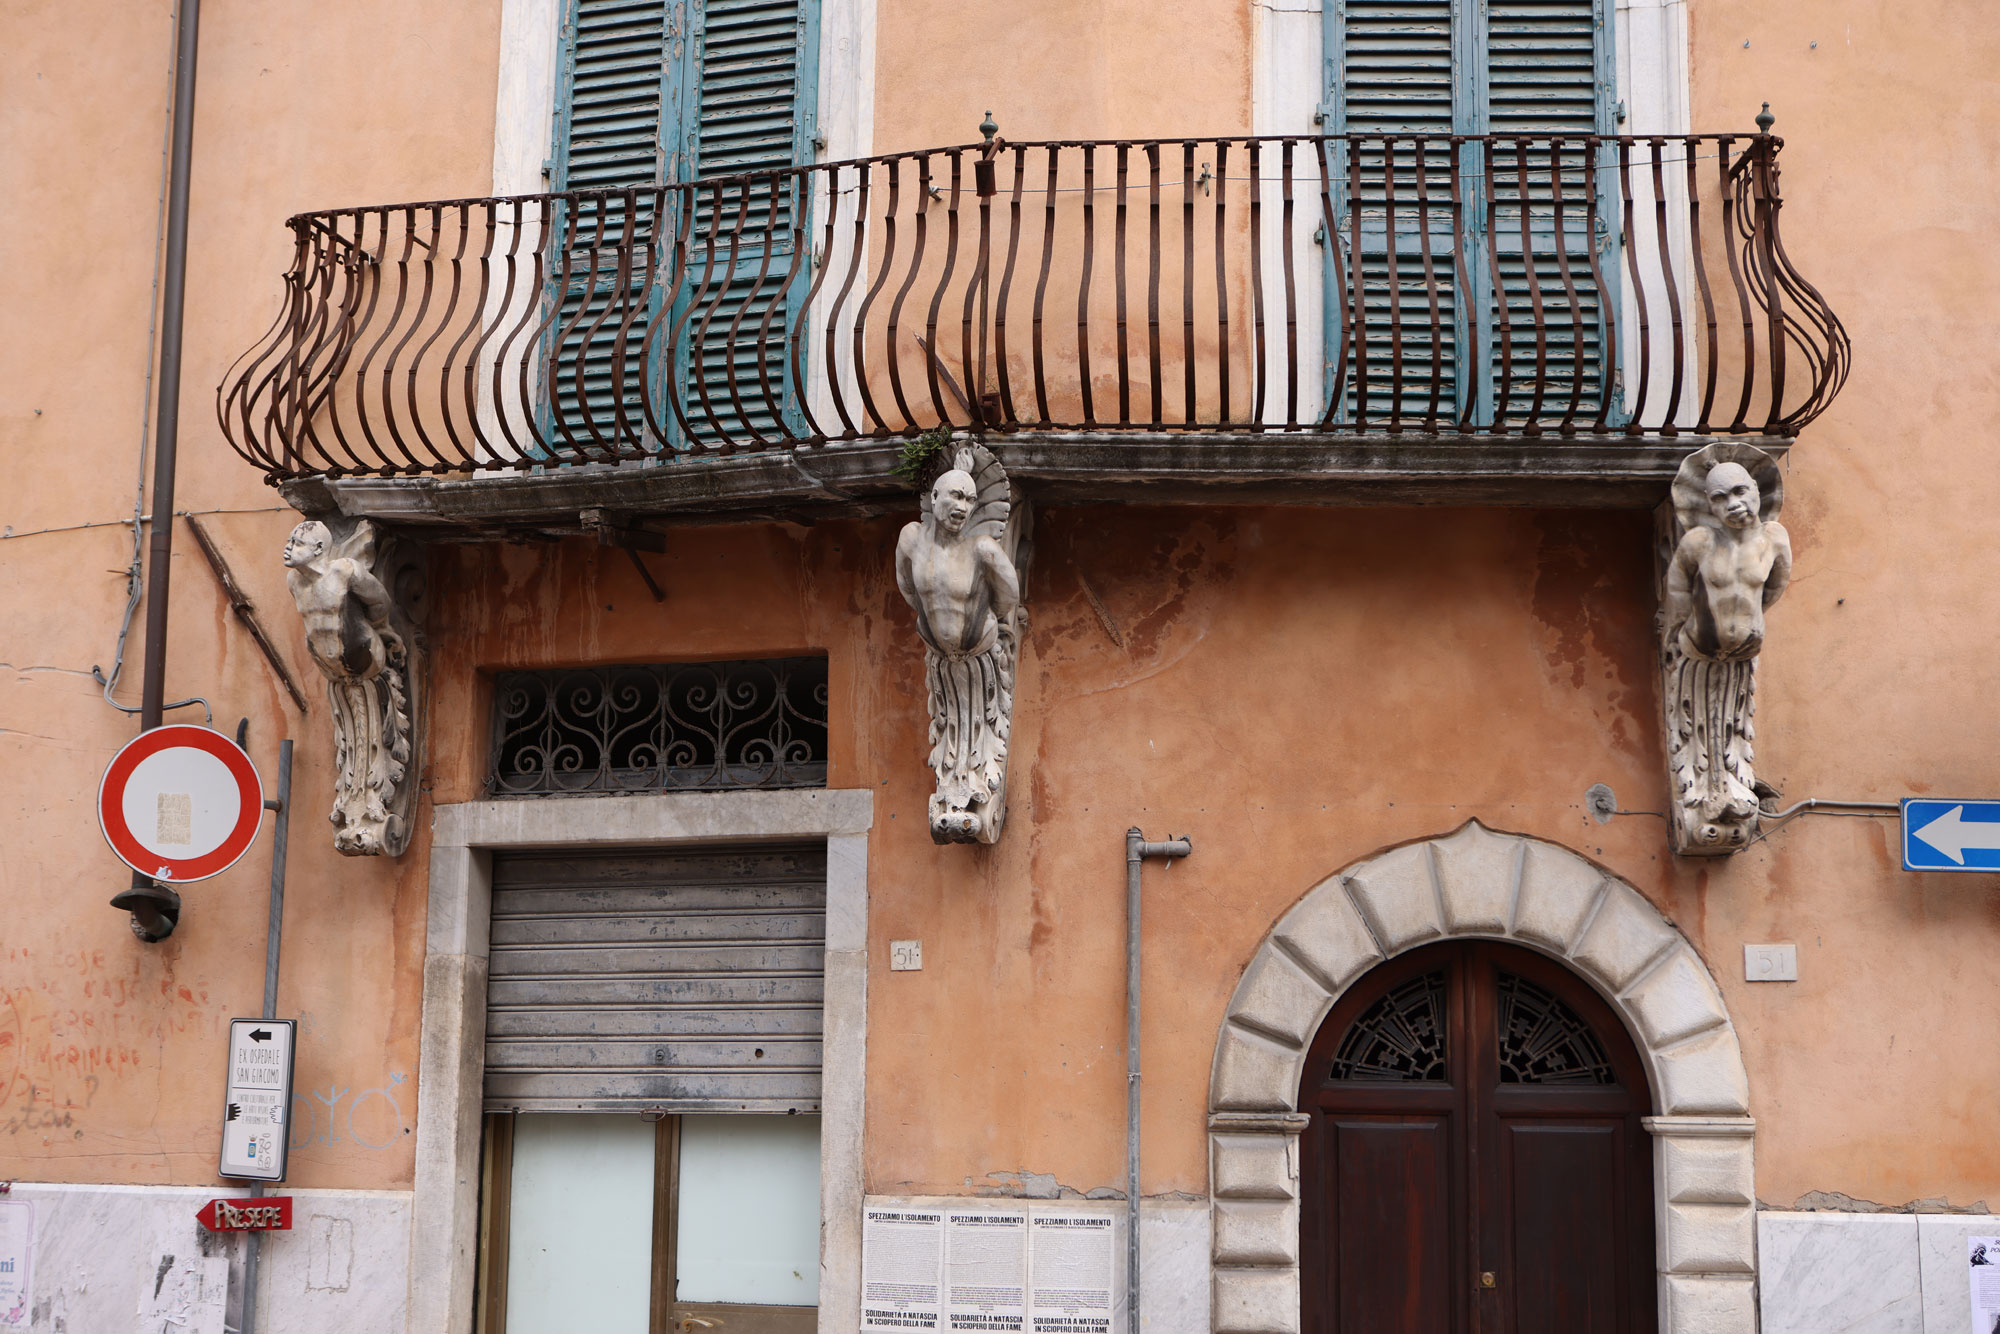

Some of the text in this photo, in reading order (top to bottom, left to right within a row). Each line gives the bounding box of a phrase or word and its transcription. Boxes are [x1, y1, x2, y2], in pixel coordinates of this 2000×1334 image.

[896, 947, 912, 966] 51
[1757, 950, 1785, 974] 51
[239, 1048, 281, 1065] EX OSPEDALE
[236, 1067, 280, 1084] SAN GIACOMO
[215, 1200, 283, 1229] PRESEPE
[868, 1212, 900, 1221] SPEZZIAMO
[901, 1213, 941, 1223] L'ISOLAMENTO
[950, 1215, 1024, 1225] SPEZZIAMO L'ISOLAMENTO
[1034, 1217, 1111, 1227] SPEZZIAMO L'ISOLAMENTO
[865, 1309, 902, 1319] SOLIDARIETÀ
[908, 1312, 938, 1321] NATASCIA
[950, 1313, 987, 1323] SOLIDARIETÀ
[994, 1315, 1023, 1324] NATASCIA
[874, 1318, 902, 1327] SCIOPERO
[920, 1320, 936, 1329] FAME
[959, 1322, 987, 1330] SCIOPERO
[988, 1323, 1005, 1331] DELLA
[1006, 1323, 1022, 1332] FAME
[1033, 1316, 1072, 1325] SOLIDARIETÀ
[1078, 1318, 1110, 1327] NATASCIA
[1035, 1325, 1108, 1334] IN SCIOPERO DELLA FAME
